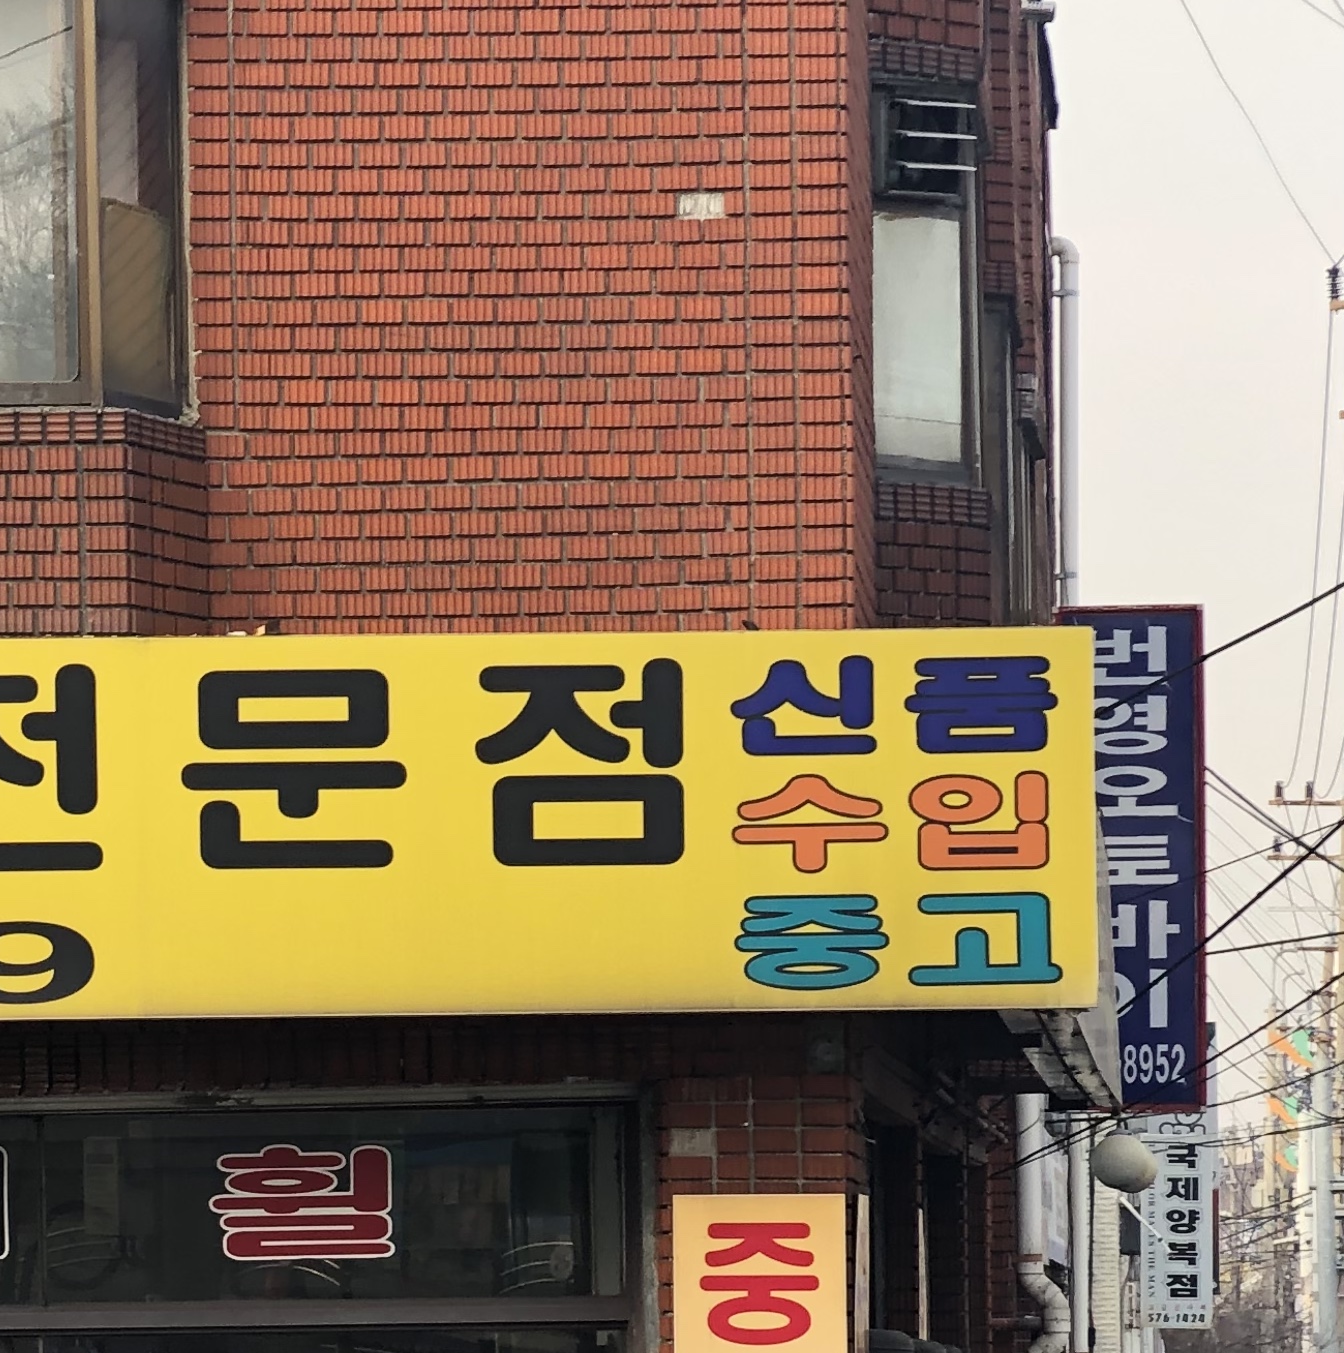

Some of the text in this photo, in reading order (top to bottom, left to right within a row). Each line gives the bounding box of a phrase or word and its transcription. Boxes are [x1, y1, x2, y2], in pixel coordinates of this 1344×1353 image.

[730, 655, 1059, 756] 신품
[731, 770, 1050, 874] 수입
[733, 892, 1063, 991] 중고
[209, 1144, 396, 1262] 휠
[1165, 1144, 1201, 1299] 국제양복점
